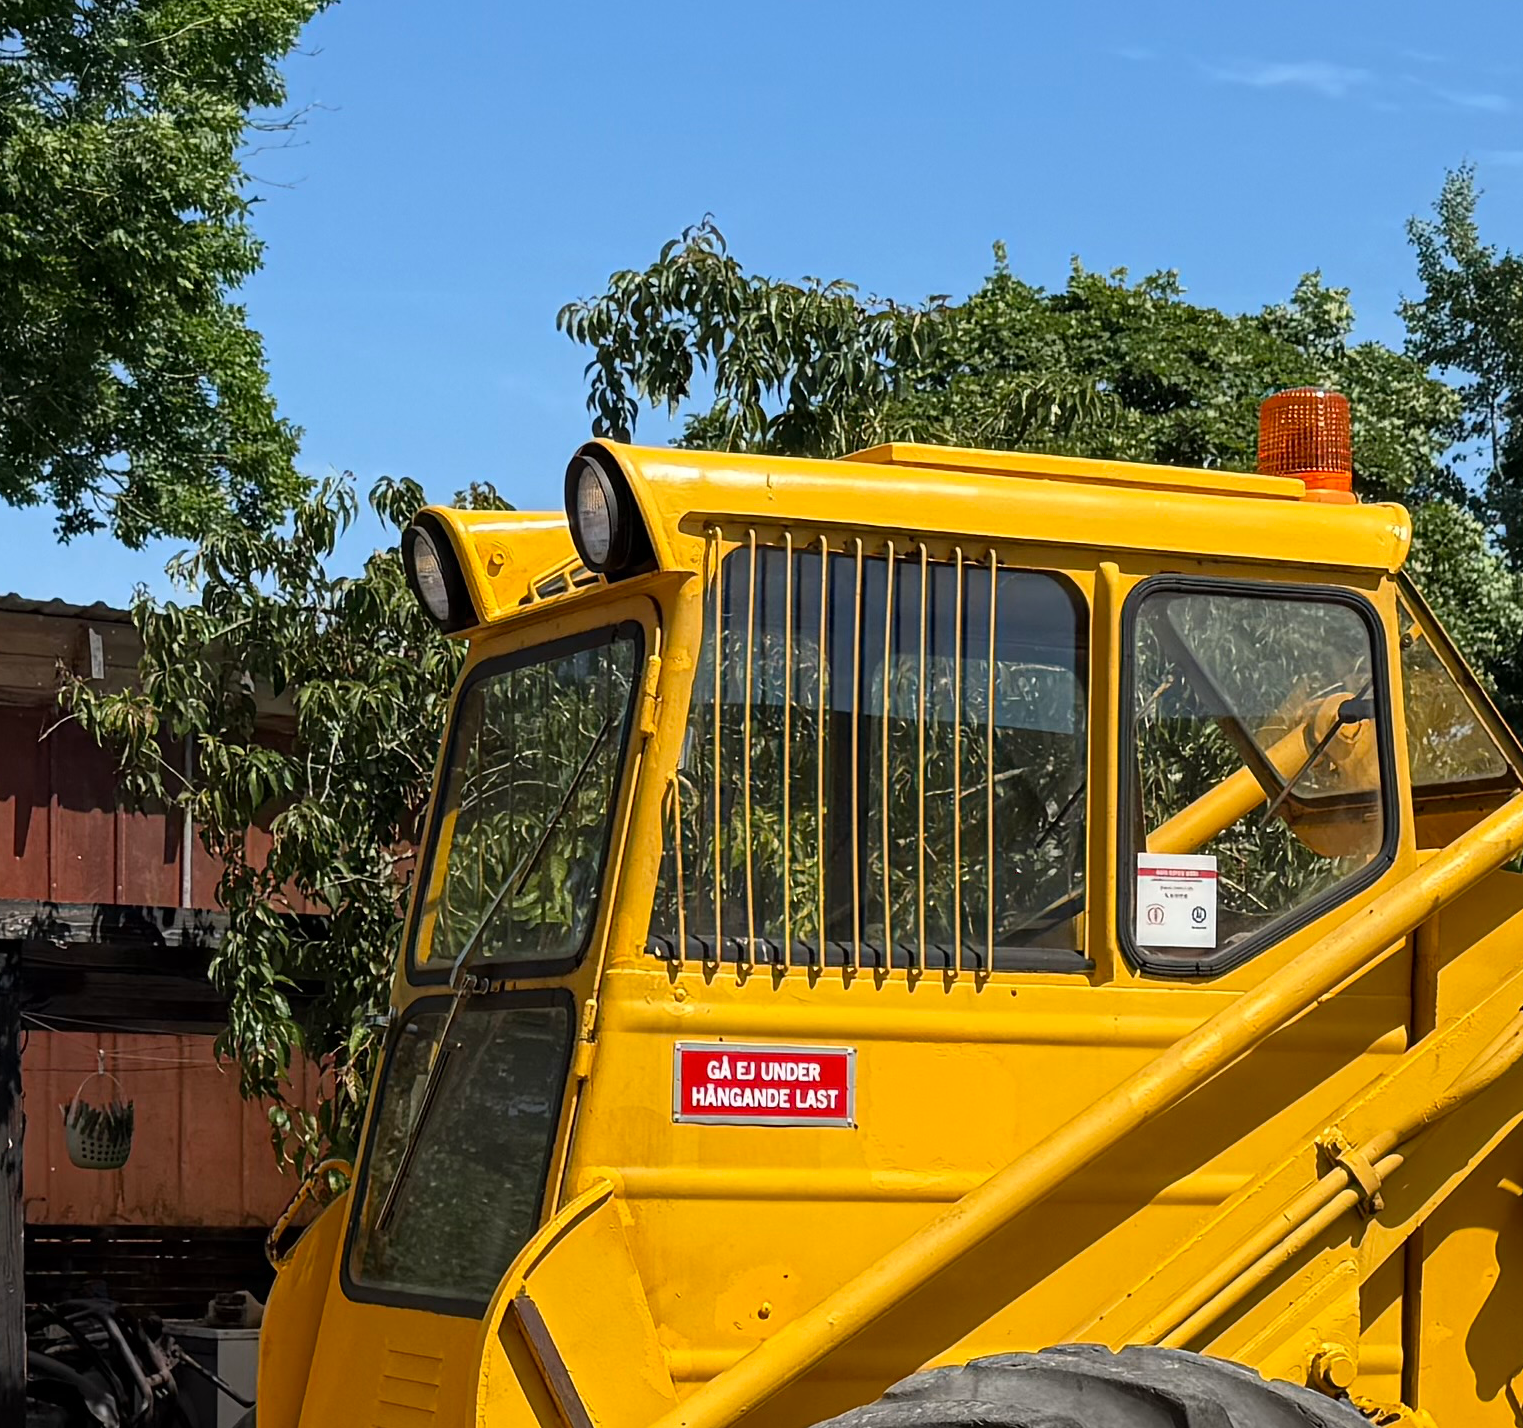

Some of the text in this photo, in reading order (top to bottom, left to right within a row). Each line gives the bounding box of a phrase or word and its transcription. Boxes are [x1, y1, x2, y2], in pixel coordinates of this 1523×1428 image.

[706, 1055, 821, 1082] GÅ EJ UNDER
[691, 1083, 839, 1109] HÄNGANDE LAST
